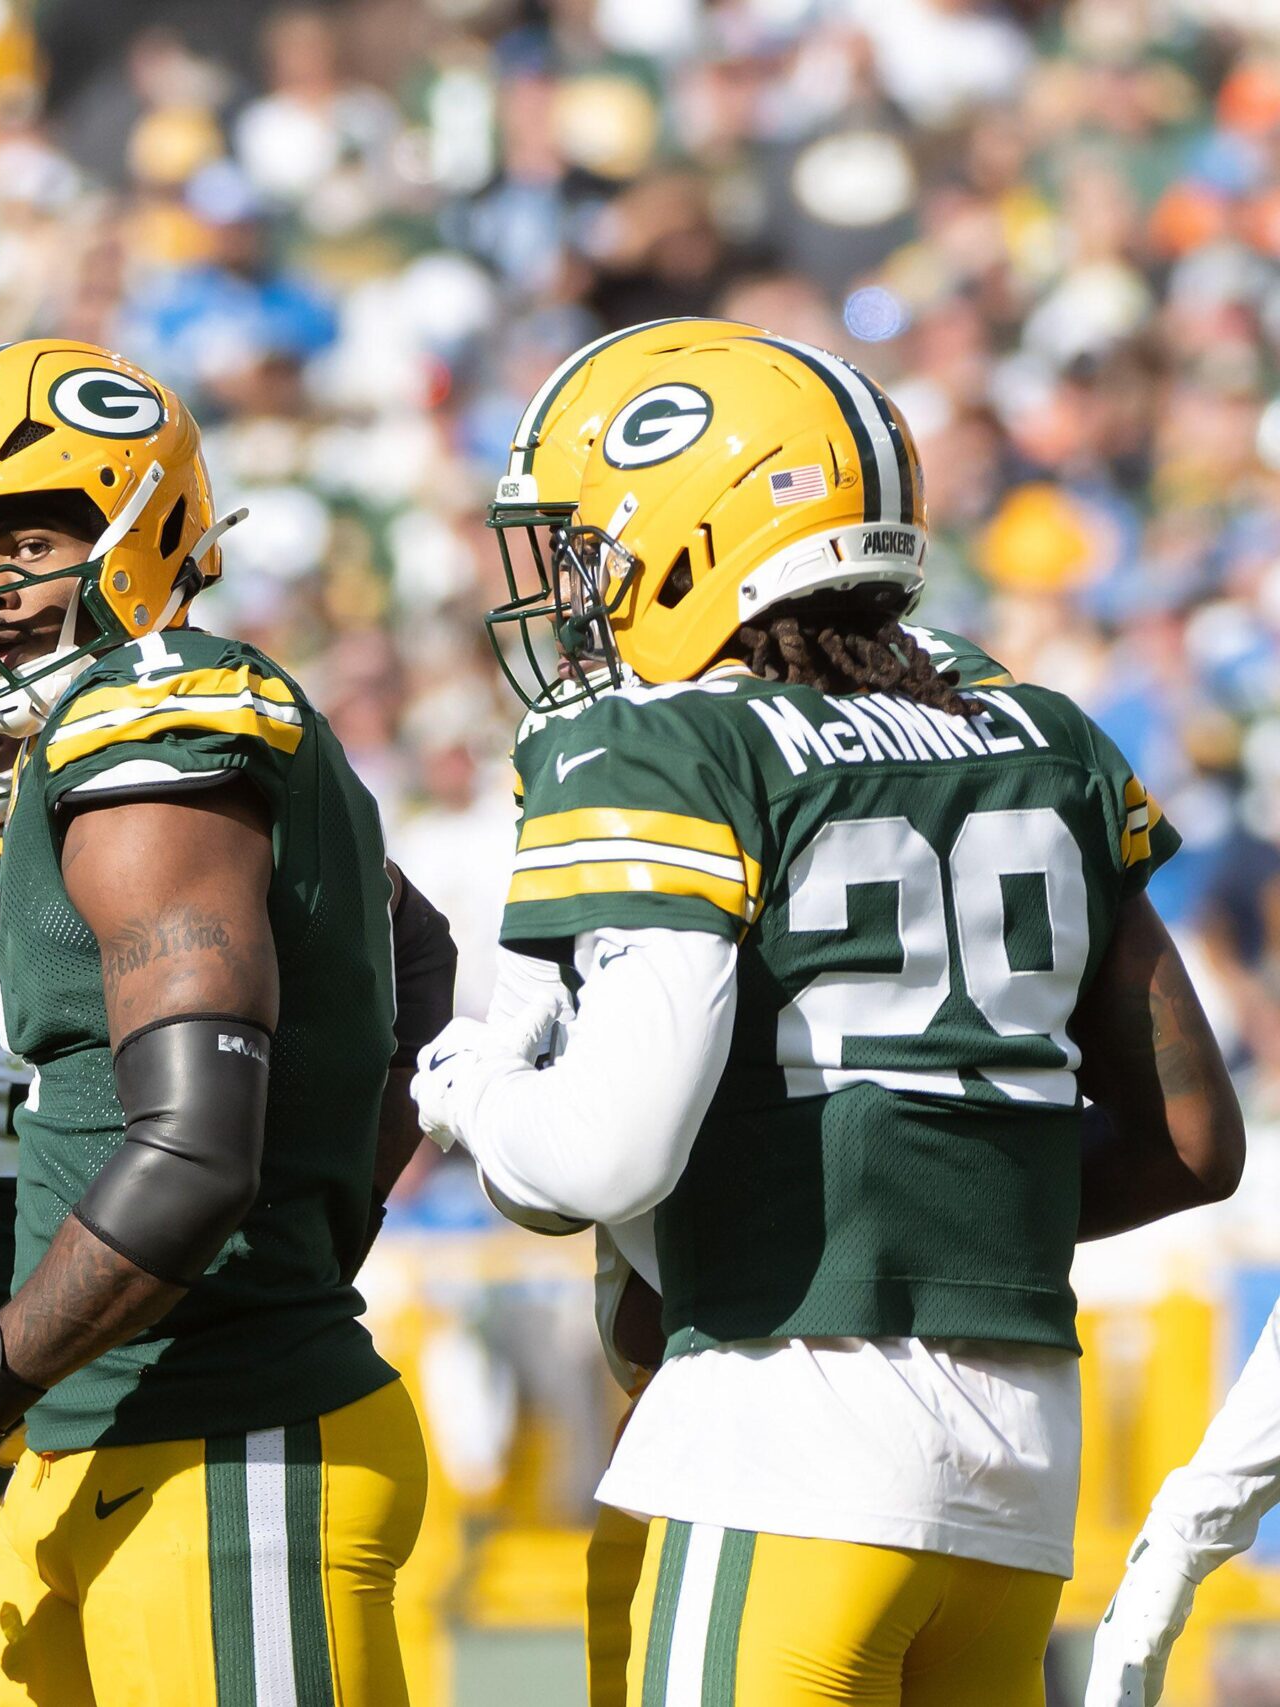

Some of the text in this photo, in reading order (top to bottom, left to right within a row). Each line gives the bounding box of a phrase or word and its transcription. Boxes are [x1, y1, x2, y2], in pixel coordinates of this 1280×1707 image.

[53, 370, 164, 437] G
[605, 384, 711, 467] G
[862, 530, 916, 556] PACKERS
[125, 631, 184, 676] 1
